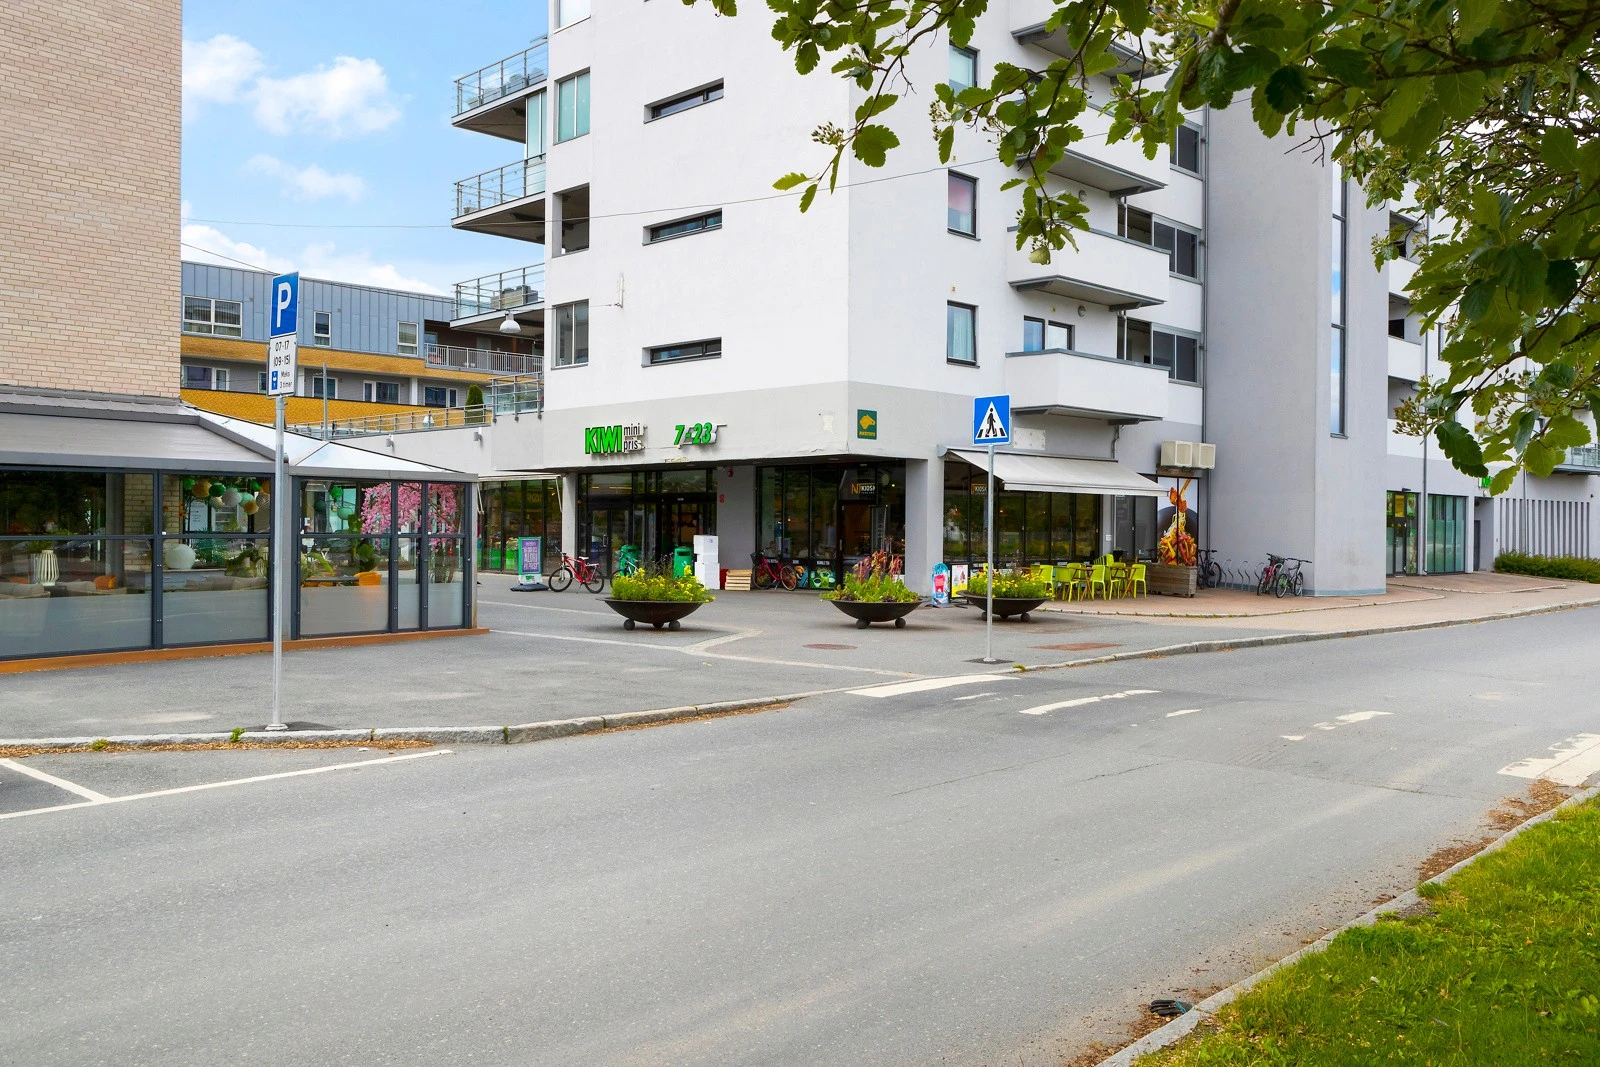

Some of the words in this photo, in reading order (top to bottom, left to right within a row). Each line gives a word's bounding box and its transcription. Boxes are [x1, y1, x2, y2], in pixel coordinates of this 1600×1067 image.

[276, 282, 292, 328] P
[275, 340, 289, 352] 07-17
[283, 380, 292, 388] timer
[624, 423, 640, 436] mini
[585, 425, 622, 454] KIWI
[624, 437, 639, 452] pris
